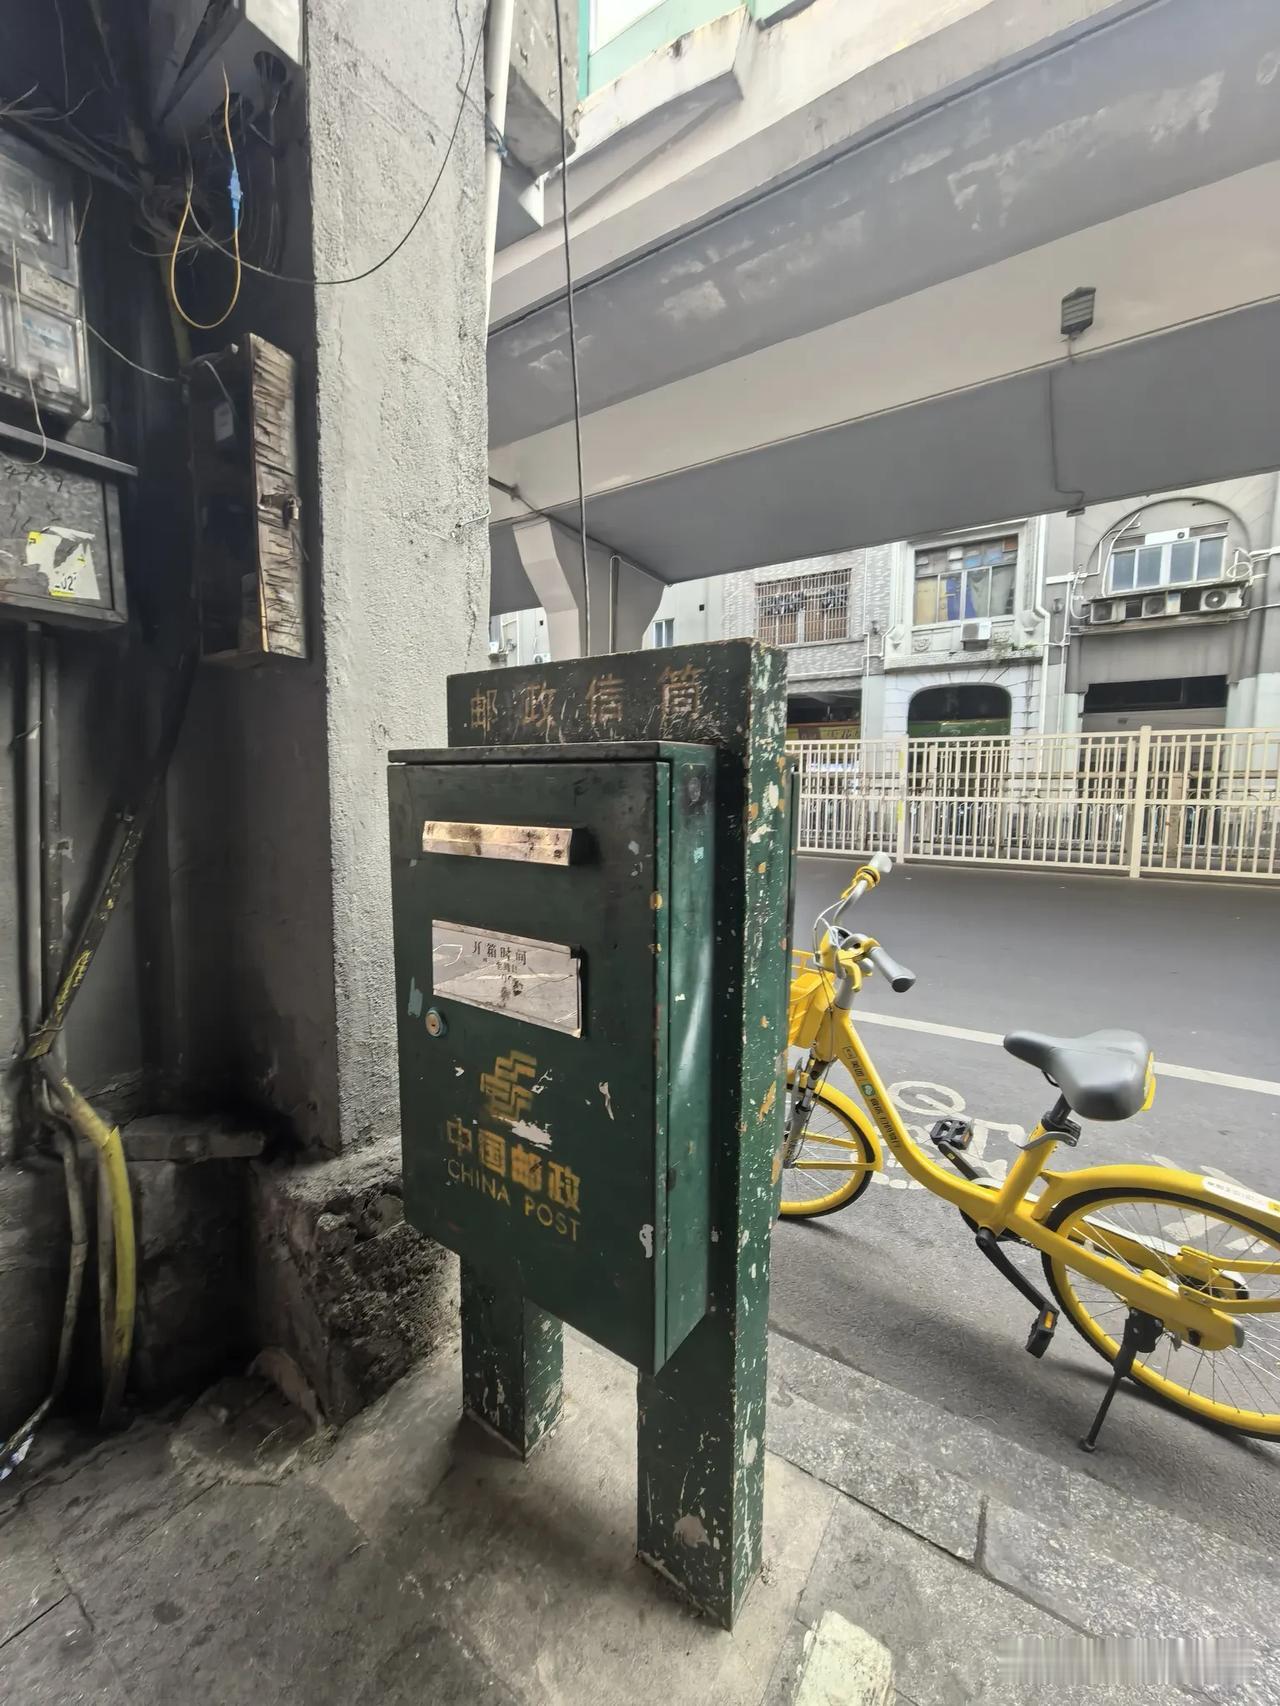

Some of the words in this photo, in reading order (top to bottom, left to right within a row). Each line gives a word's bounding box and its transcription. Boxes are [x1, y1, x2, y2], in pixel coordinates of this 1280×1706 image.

[447, 1117, 580, 1213] 中国邮政
[447, 1159, 511, 1207] CHINA
[524, 1195, 581, 1242] POST
